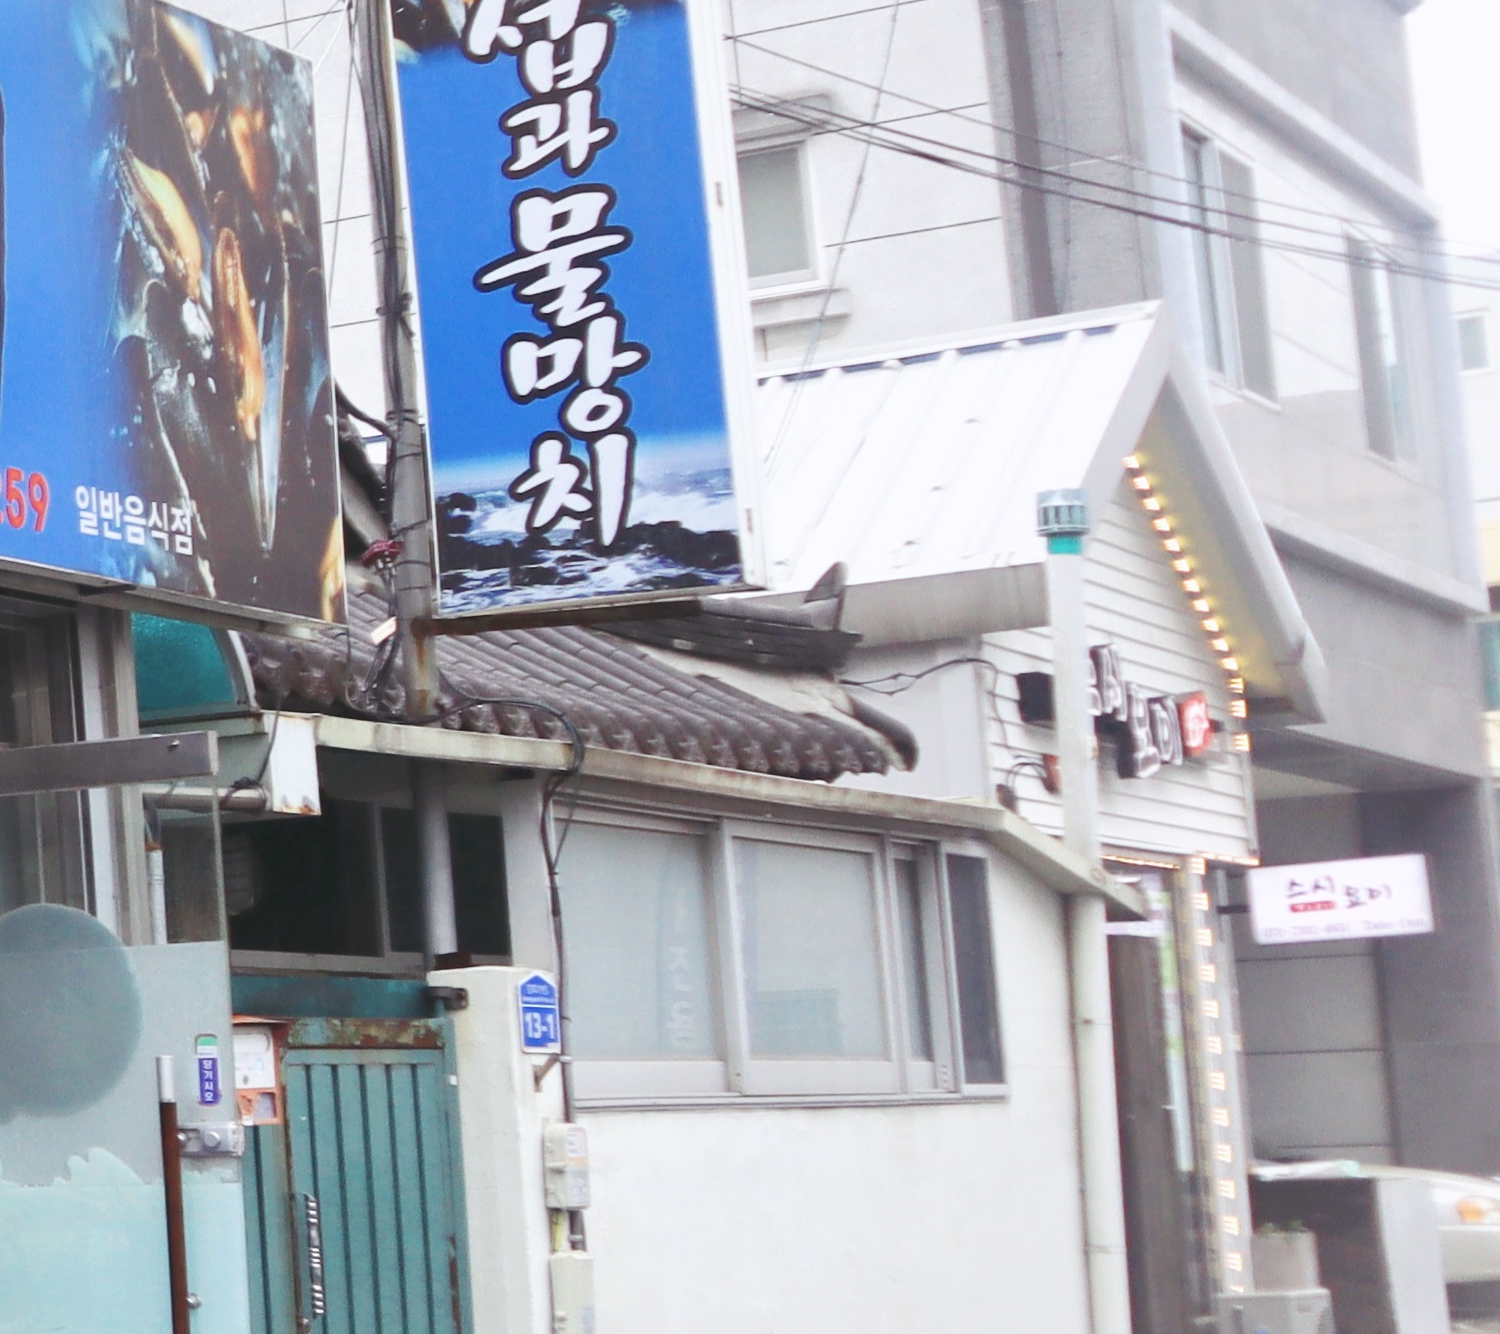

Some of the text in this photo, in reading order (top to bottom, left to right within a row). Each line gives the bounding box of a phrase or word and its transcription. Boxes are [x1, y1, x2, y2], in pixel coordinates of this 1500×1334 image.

[474, 184, 649, 547] 물망치
[75, 485, 194, 556] 일반음식점
[524, 1012, 555, 1040] 13-1
